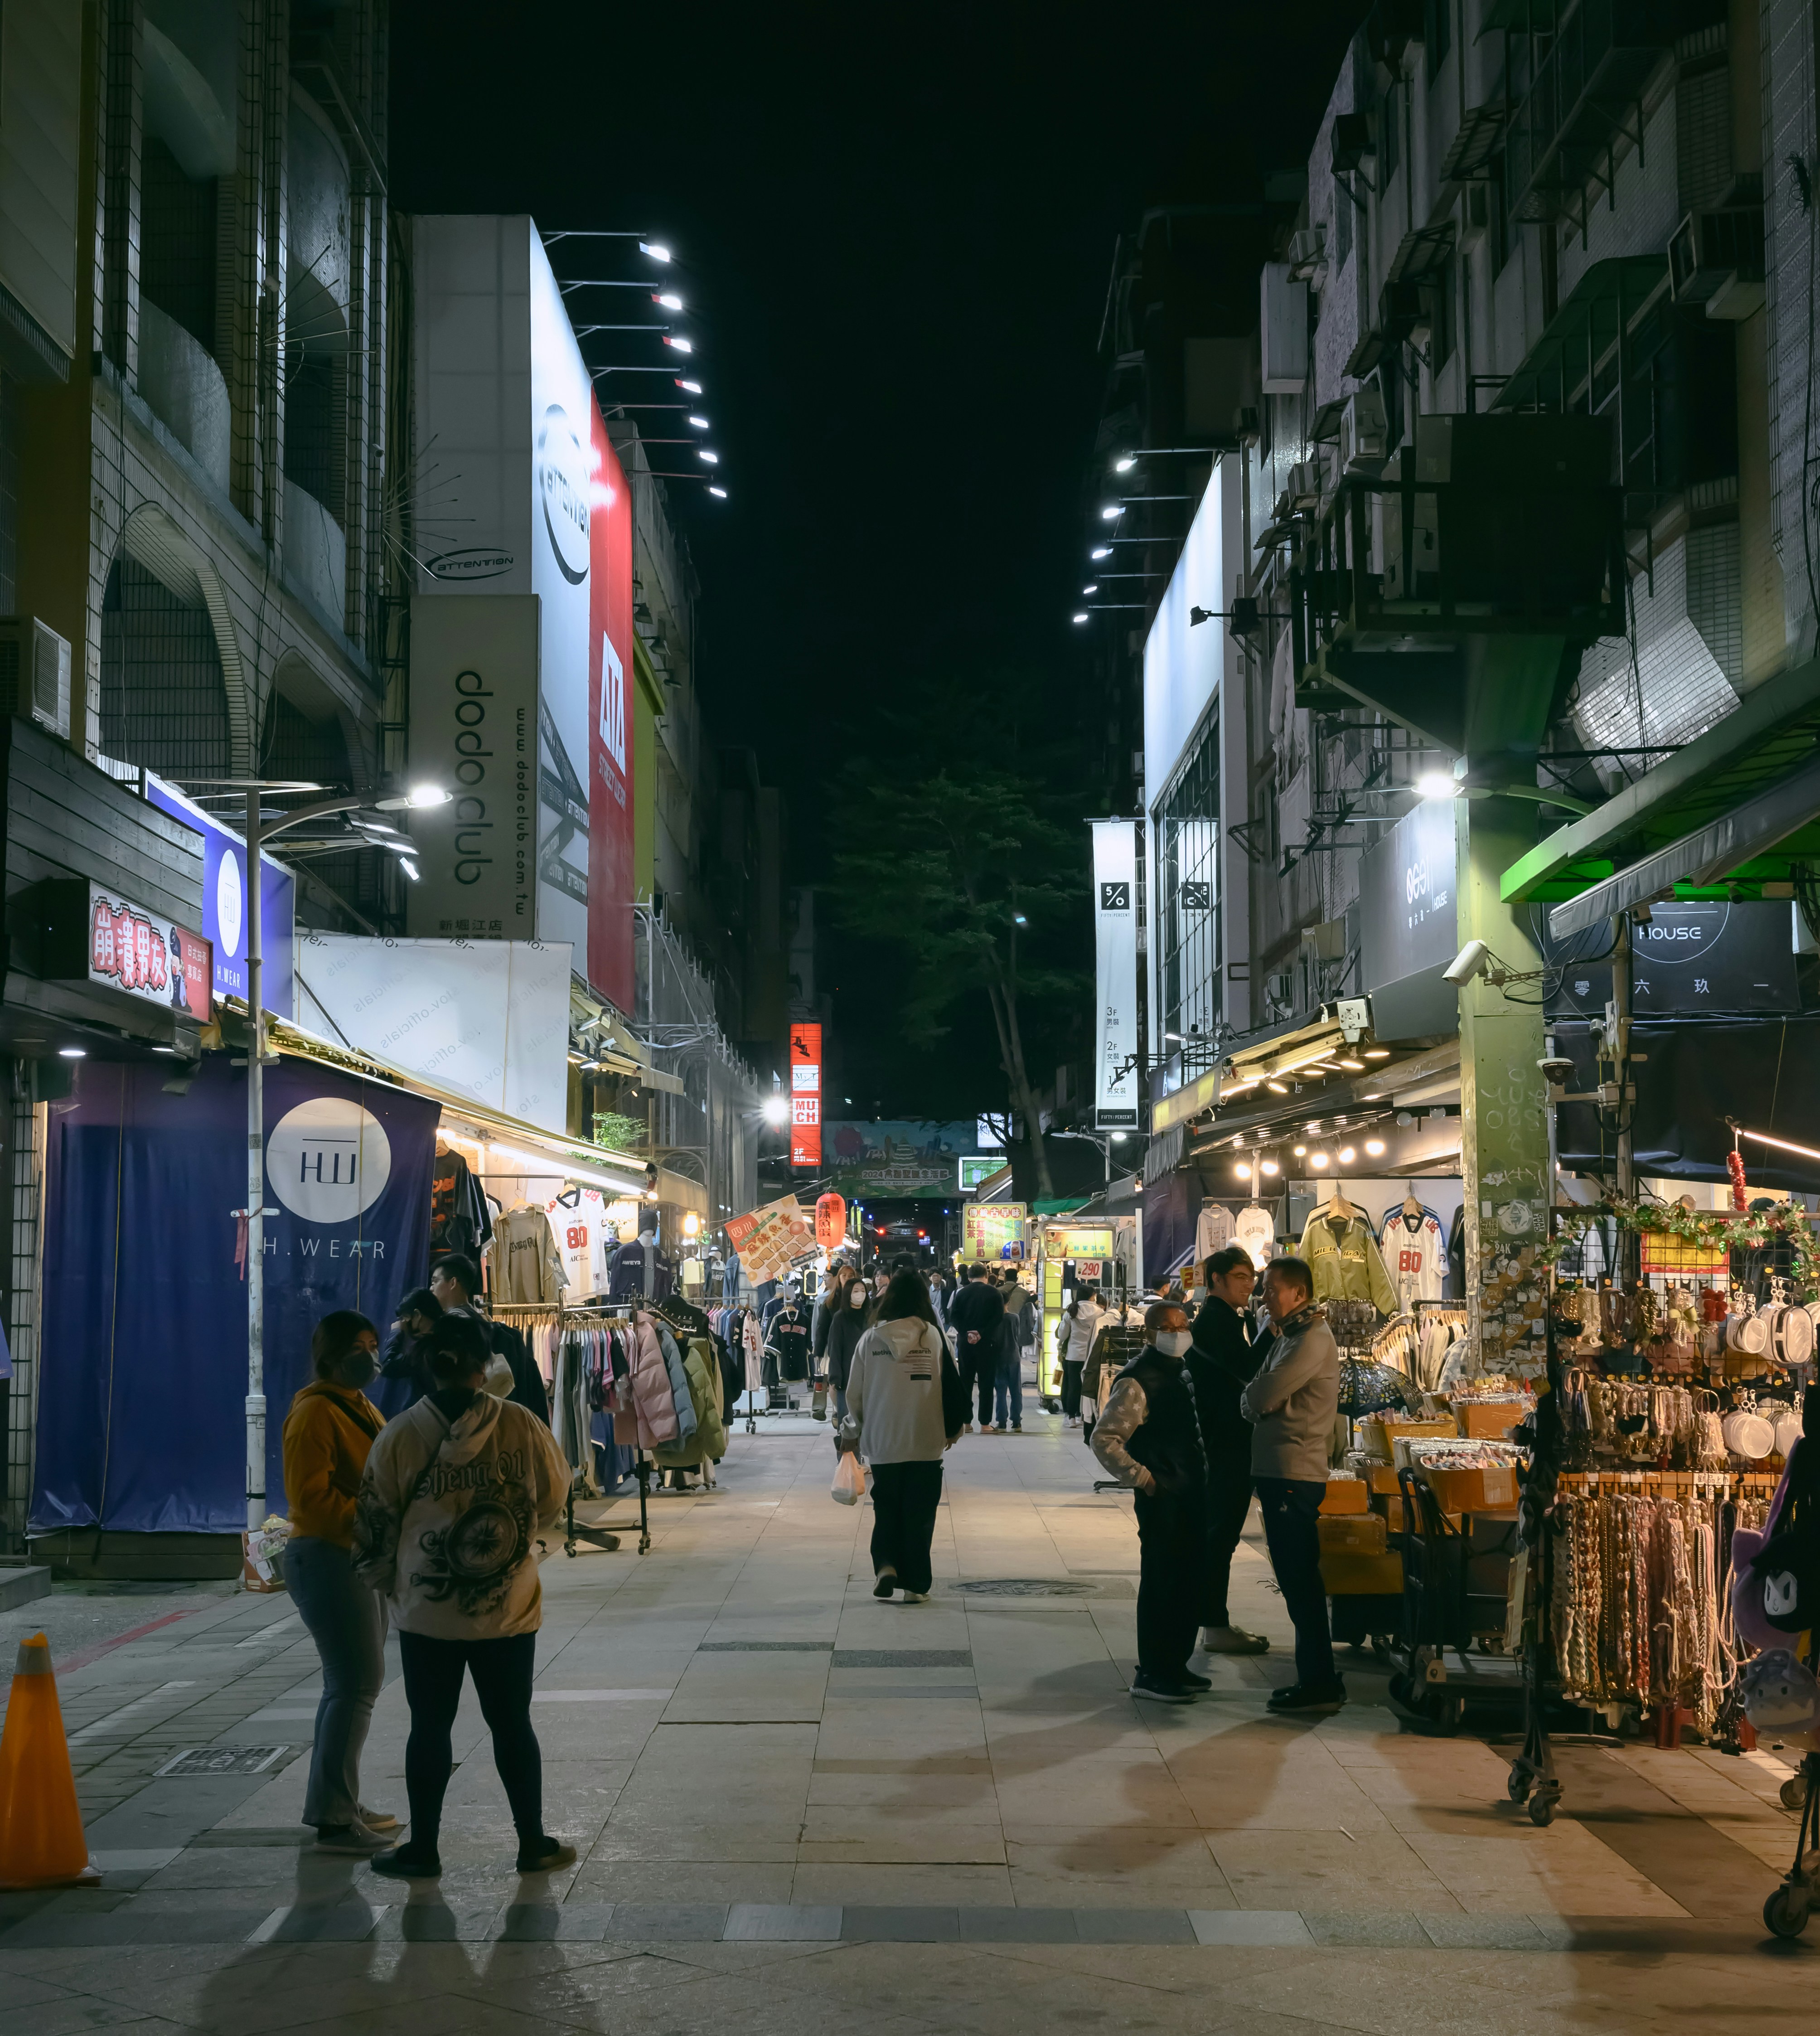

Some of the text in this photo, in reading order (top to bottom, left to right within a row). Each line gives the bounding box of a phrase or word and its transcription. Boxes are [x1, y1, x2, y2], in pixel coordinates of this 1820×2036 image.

[600, 630, 626, 777] ATA
[95, 908, 165, 984] 崩潰男友
[217, 965, 240, 989] H.WEAR
[1107, 1041, 1118, 1051] 2F
[969, 1208, 1020, 1217] 傳統古早味
[566, 1226, 587, 1250] 80
[731, 1221, 754, 1238] 四川
[967, 1220, 976, 1239] 紅茶
[263, 1237, 384, 1259] H.WEAR
[1314, 1246, 1336, 1256] MICH
[1495, 1243, 1511, 1254] 24K
[1081, 1262, 1099, 1276] 290
[1399, 1250, 1422, 1273] 80
